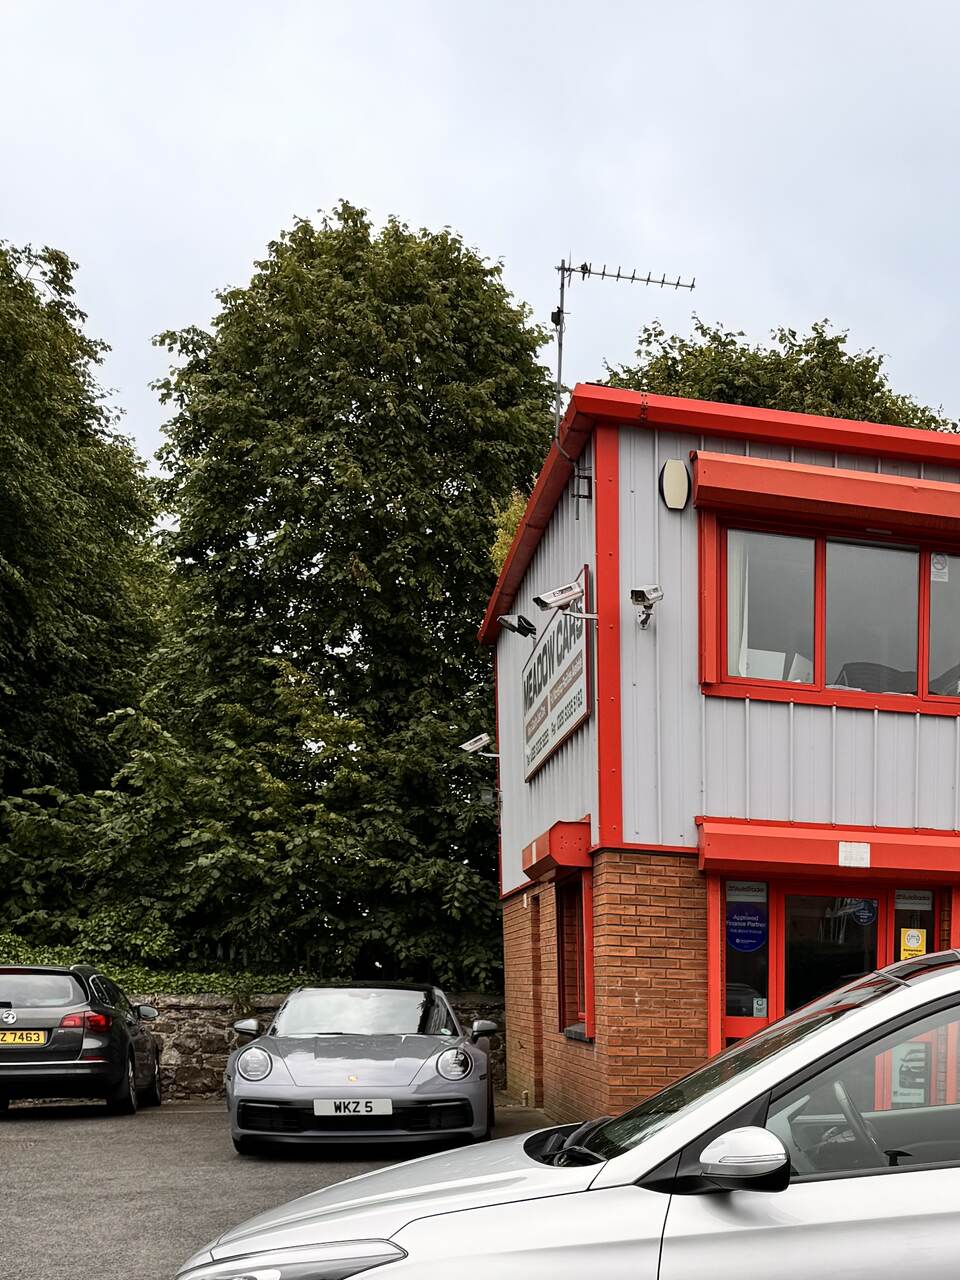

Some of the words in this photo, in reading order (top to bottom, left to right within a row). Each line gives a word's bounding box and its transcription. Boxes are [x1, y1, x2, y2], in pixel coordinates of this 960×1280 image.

[523, 630, 555, 717] MEADOW
[10, 1032, 40, 1042] 7463
[333, 1101, 361, 1113] WKZ
[364, 1101, 373, 1113] 5
